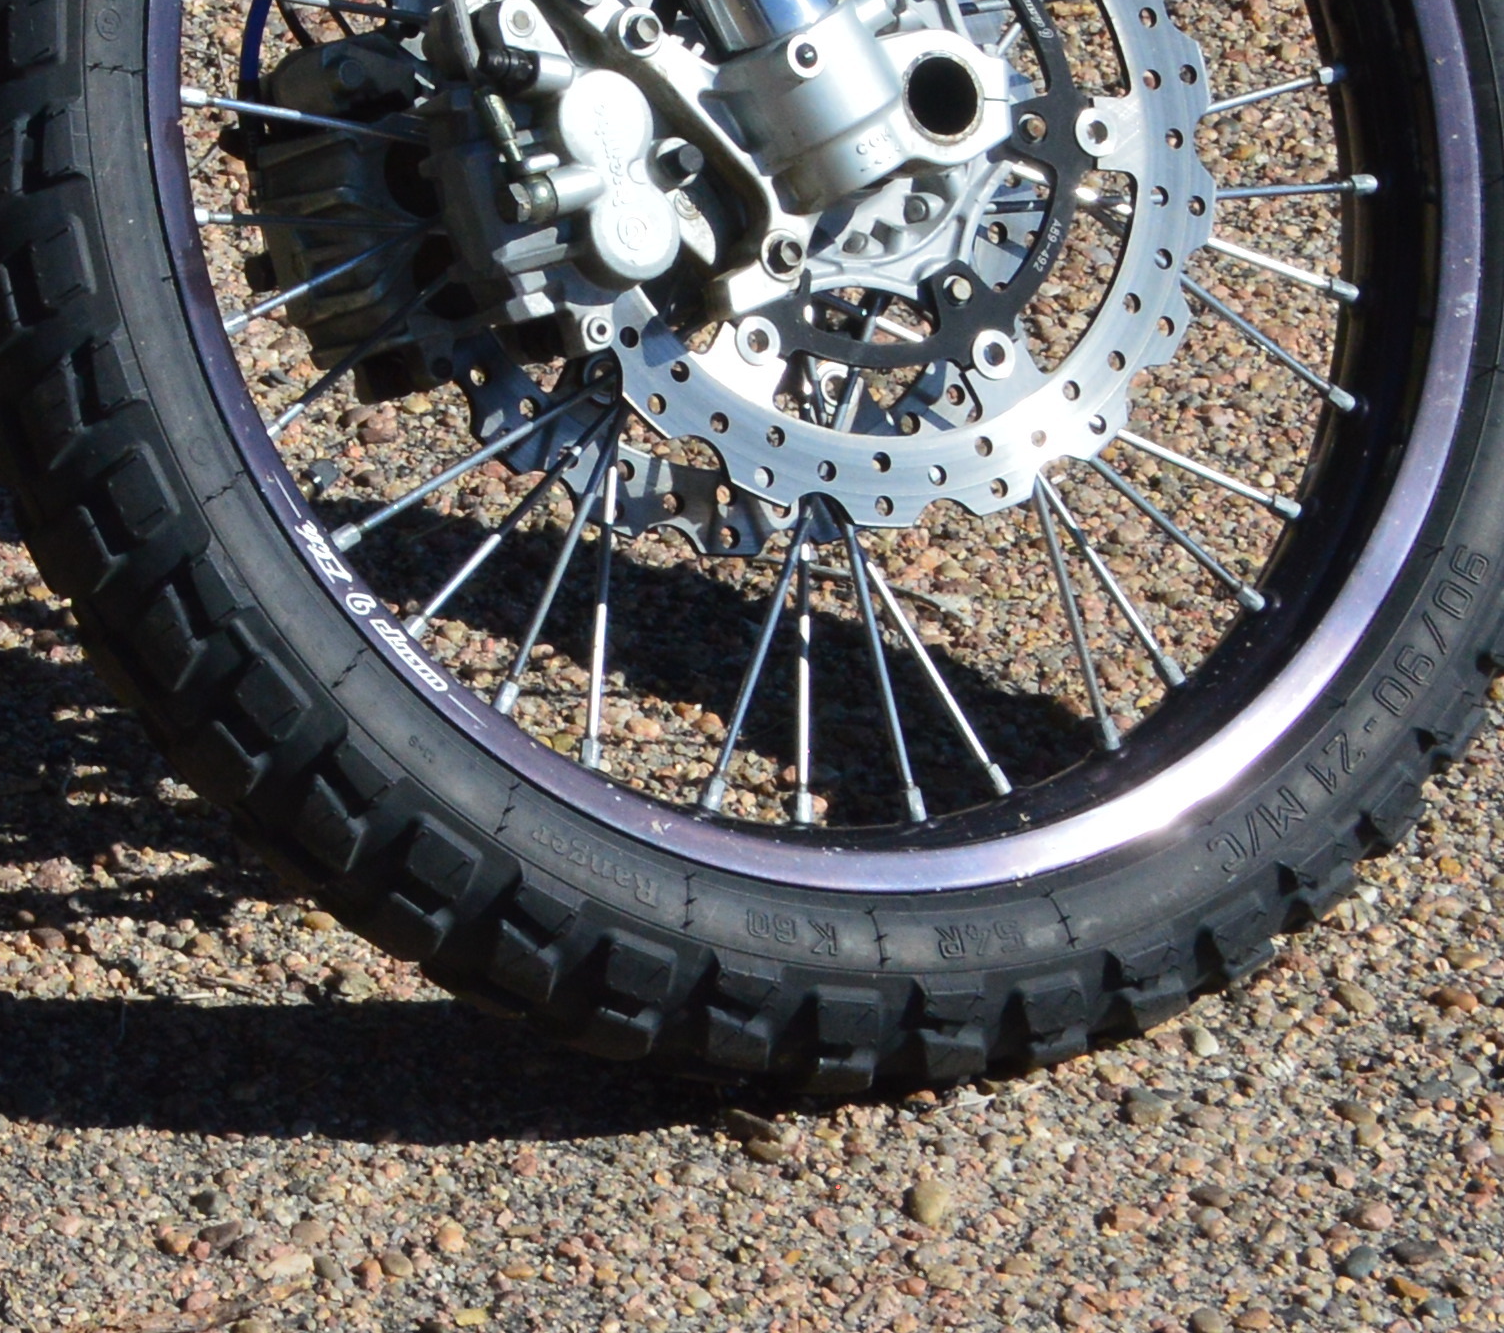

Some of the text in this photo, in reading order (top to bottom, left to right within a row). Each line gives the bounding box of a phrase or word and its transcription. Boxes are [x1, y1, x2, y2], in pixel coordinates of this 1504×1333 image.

[294, 521, 353, 582] Elite
[345, 591, 377, 618] 9
[1207, 547, 1490, 873] 90/90-21 M/C
[532, 825, 659, 907] Ranger
